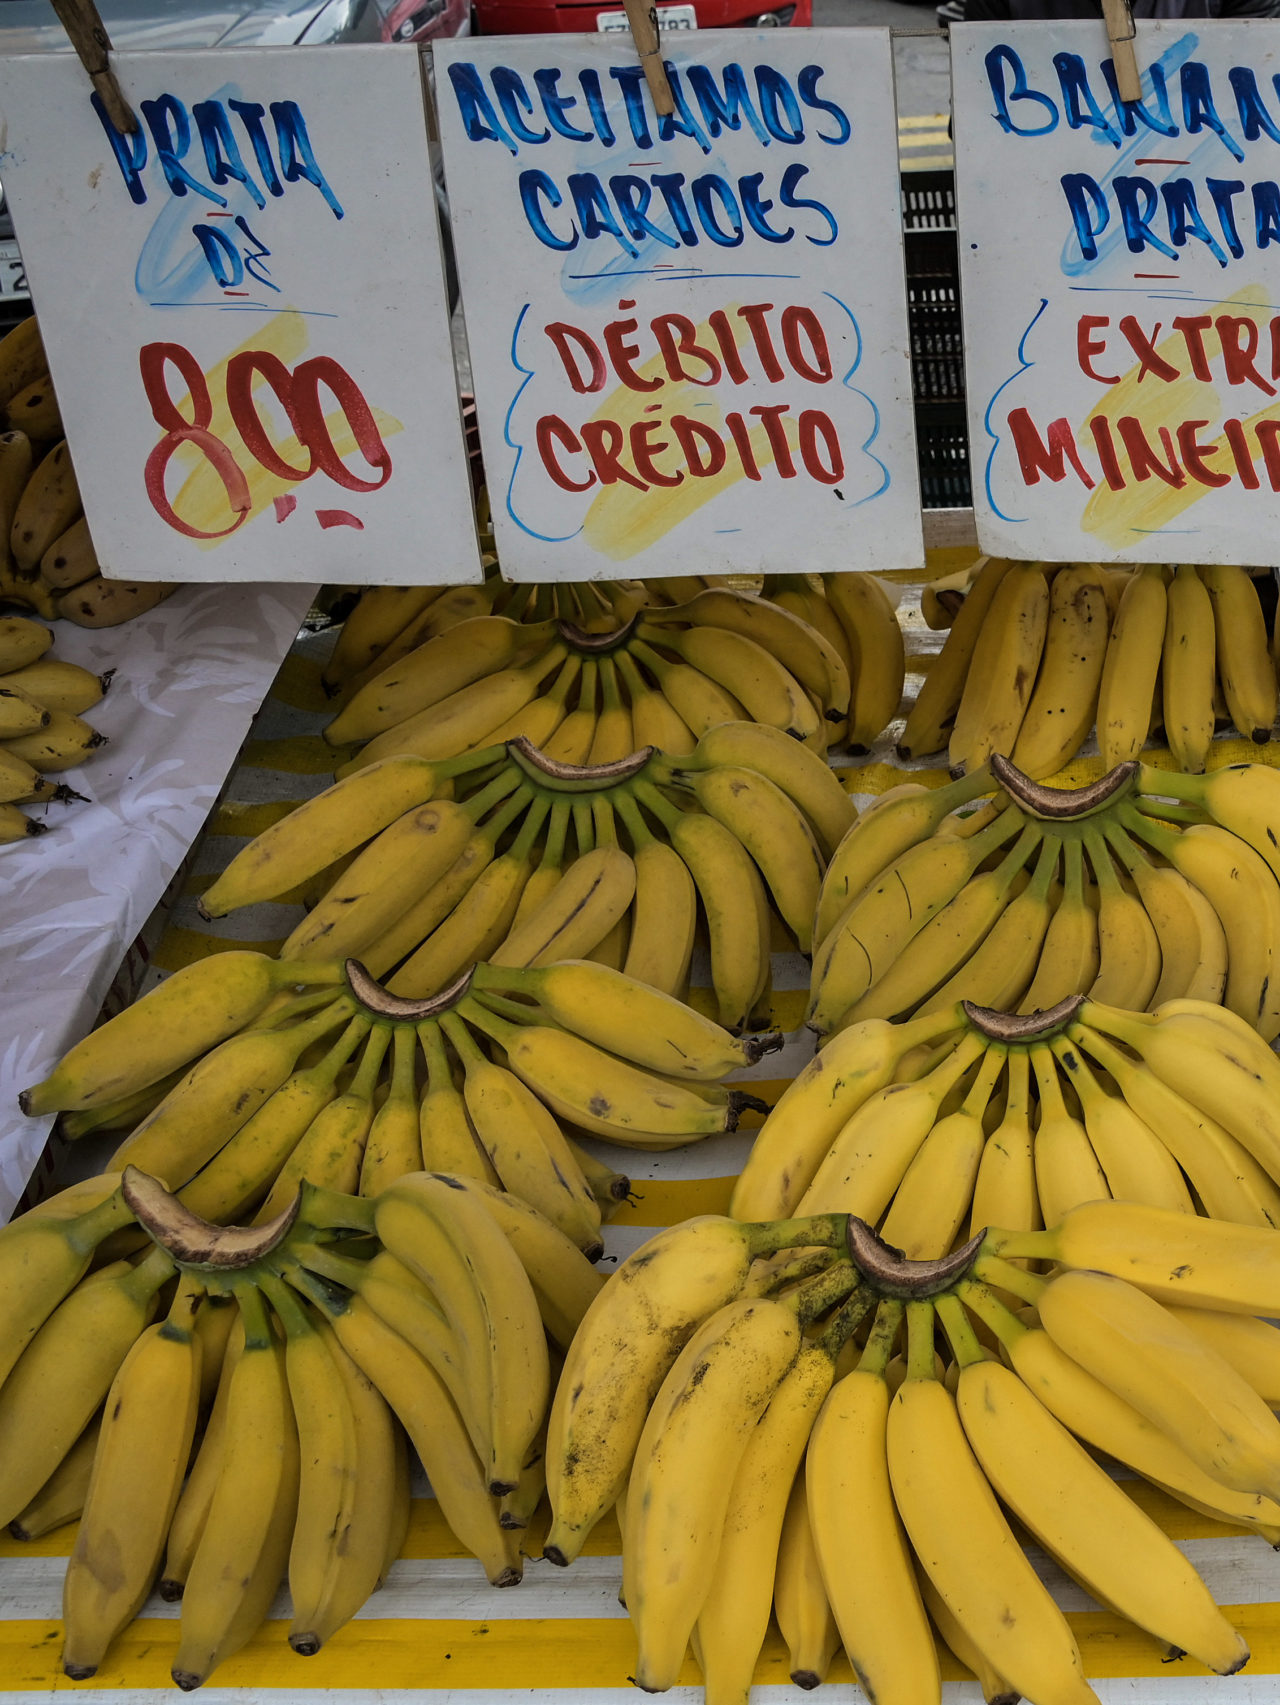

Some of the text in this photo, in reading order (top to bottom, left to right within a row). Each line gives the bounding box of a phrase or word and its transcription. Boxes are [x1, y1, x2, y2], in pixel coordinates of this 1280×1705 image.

[90, 91, 345, 220] PRATA
[447, 61, 851, 156] ACEITAMOS
[518, 163, 838, 259] CARTOES
[544, 298, 833, 394] DÉBITO
[535, 403, 845, 493] CRÉDITO
